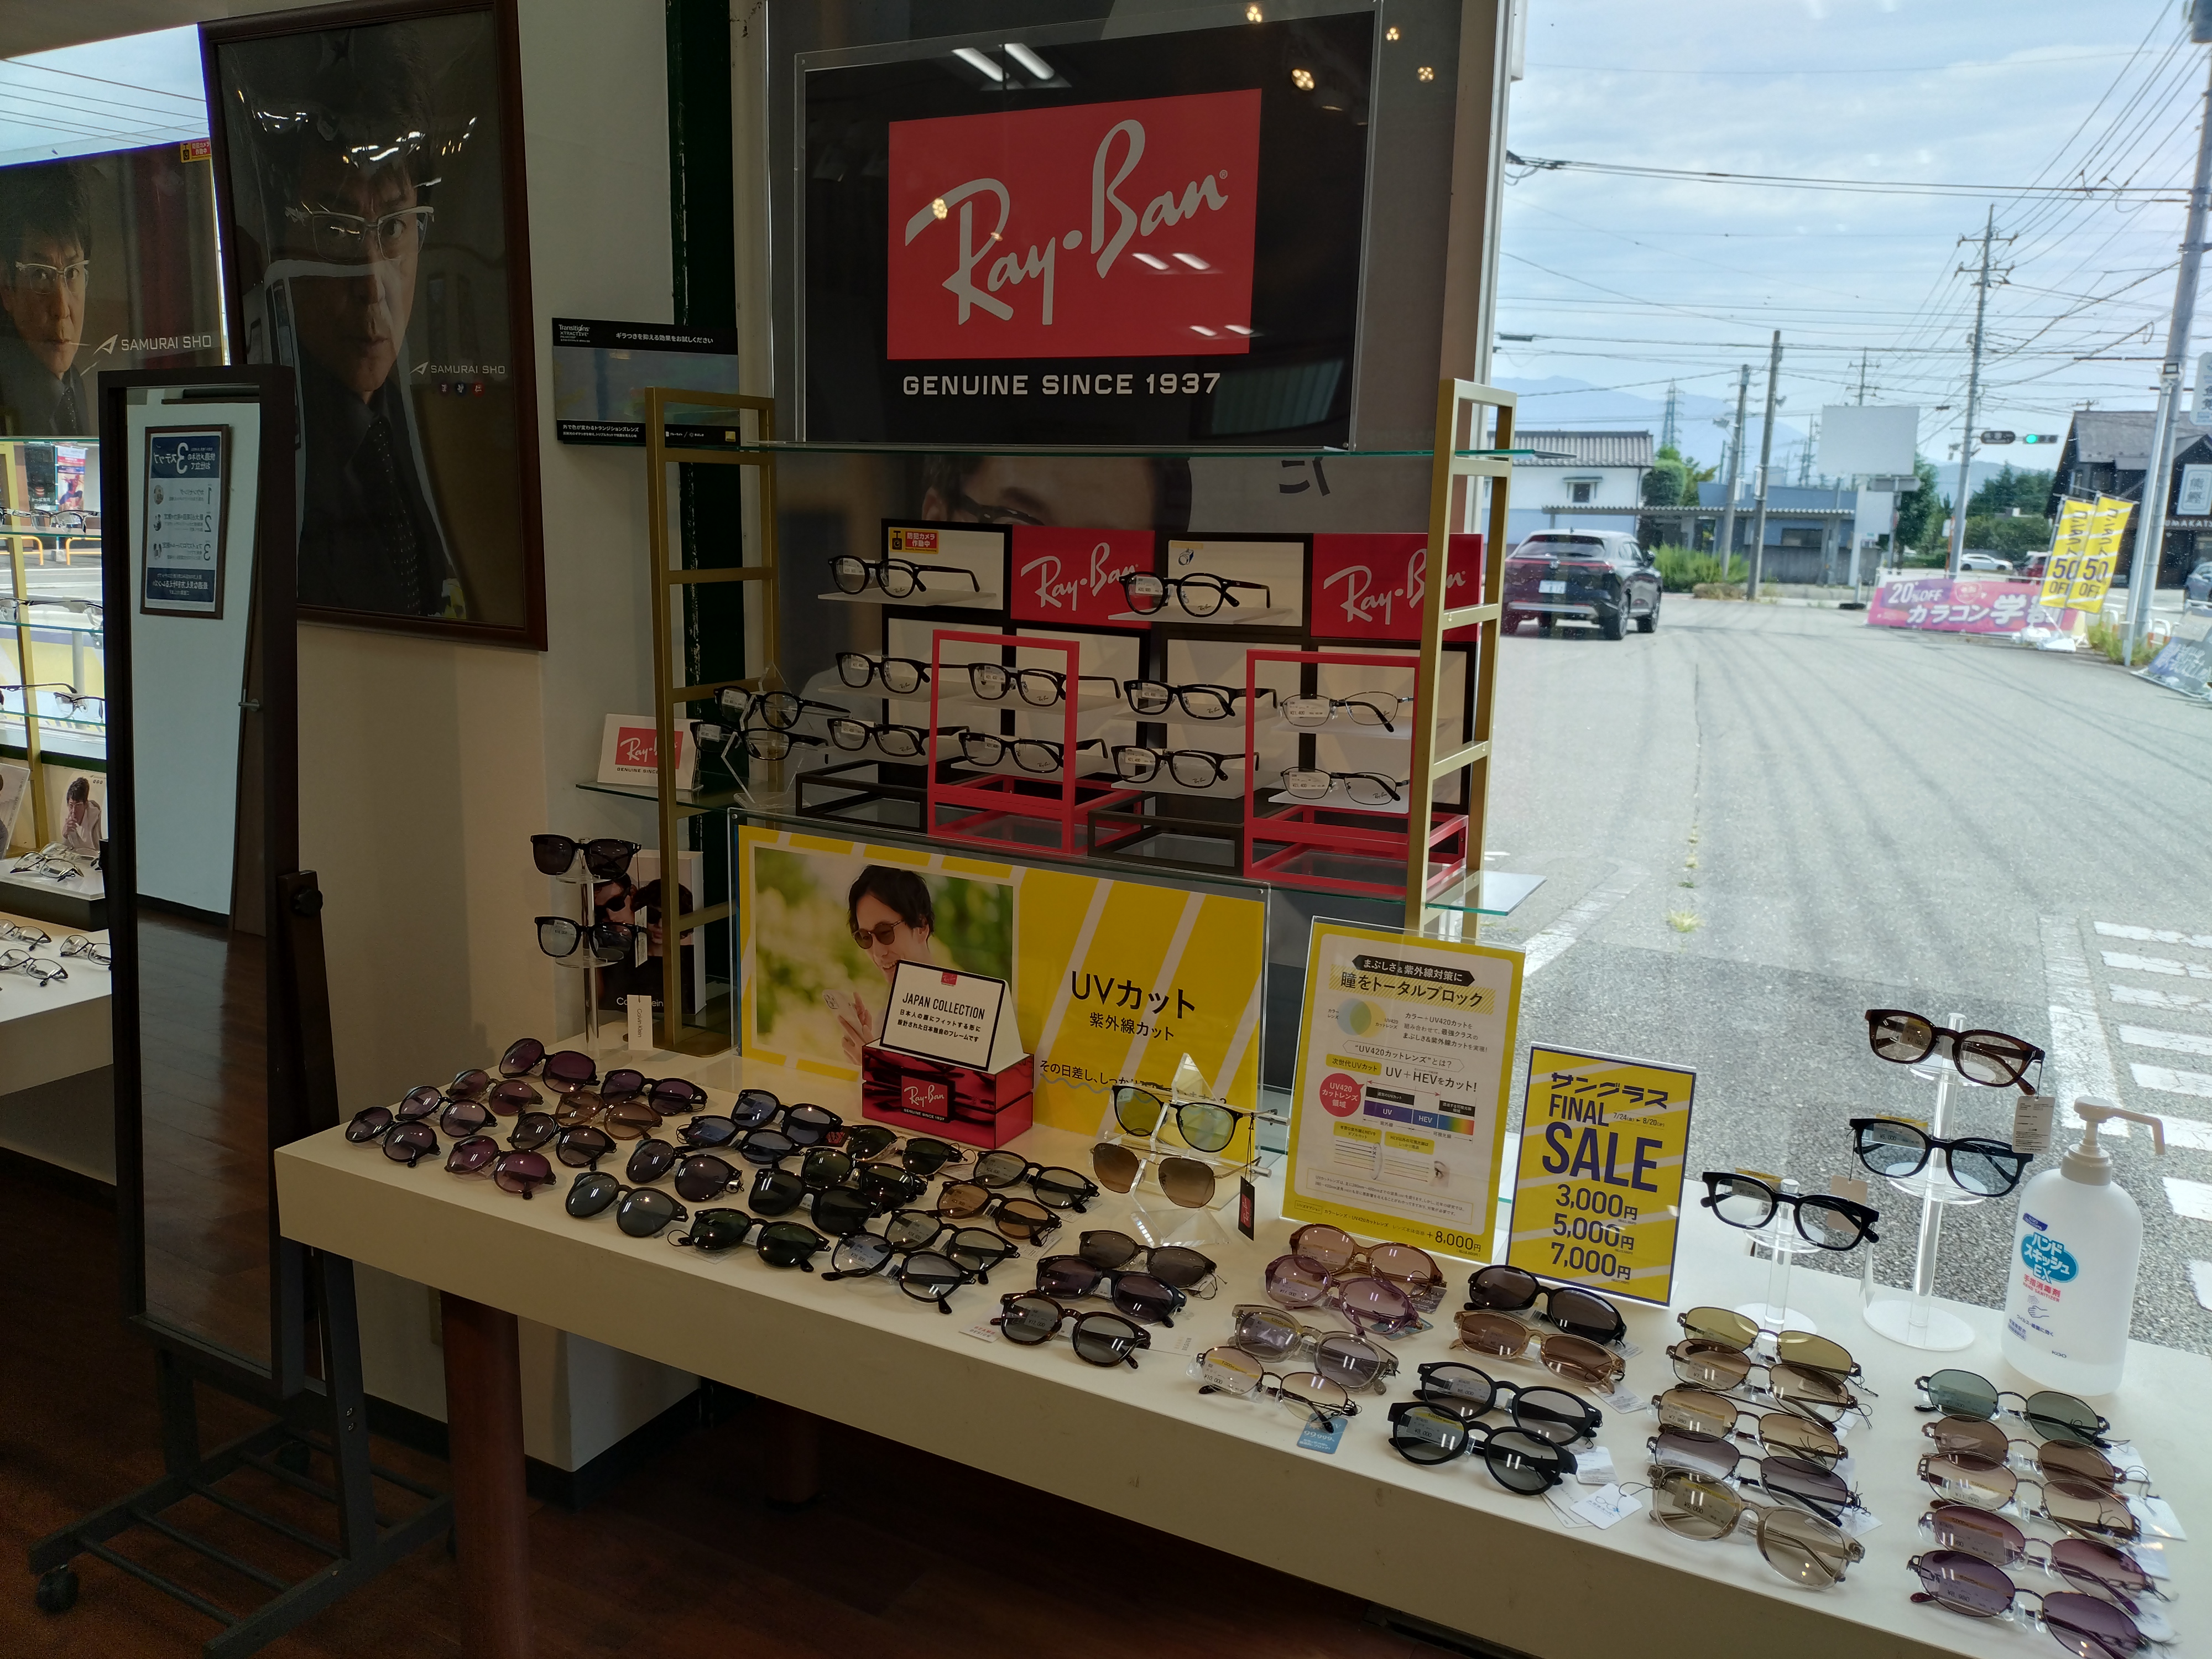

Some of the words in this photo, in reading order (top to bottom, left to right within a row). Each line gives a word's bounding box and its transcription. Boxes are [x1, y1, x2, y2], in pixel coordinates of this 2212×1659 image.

[122, 337, 178, 351] SAMURAI
[183, 335, 212, 348] SHO
[431, 365, 478, 374] SAMURAI
[483, 365, 505, 374] SHO
[904, 374, 1028, 396] GENUINE
[1042, 374, 1133, 395] SINCE
[1145, 373, 1221, 394] 1937
[906, 533, 935, 541] 防犯カメラ
[1363, 958, 1463, 982] まぶしさ&紫外線対策に
[1071, 969, 1196, 1019] UVカット
[1340, 971, 1484, 1008] 瞳をトータルブロック
[902, 993, 930, 1006] JAPAN
[932, 999, 985, 1020] COLLECTION
[897, 1020, 978, 1042] 設計された日本独自のフレームです
[899, 1009, 980, 1032] 日本人の顔にフィットする形に
[1090, 1011, 1175, 1041] 紫外線カット
[1332, 1057, 1378, 1072] 次世代UVカット
[1322, 1089, 1359, 1102] カットレンズ
[1329, 1082, 1353, 1093] UV420
[1551, 1072, 1668, 1110] サングラス
[1418, 1115, 1433, 1123] HEV
[1549, 1093, 1609, 1127] FINAL
[1542, 1121, 1663, 1193] SALE
[1556, 1183, 1638, 1221] 3,000円
[1552, 1212, 1635, 1250] 5,000円
[2032, 1233, 2063, 1254] ハンド
[1550, 1241, 1631, 1280] 7,000円
[2024, 1244, 2070, 1276] スキッシュ
[2032, 1263, 2053, 1284] EX
[1204, 1373, 1223, 1385] ¥10,000
[1684, 1501, 1703, 1514] ¥5,000
